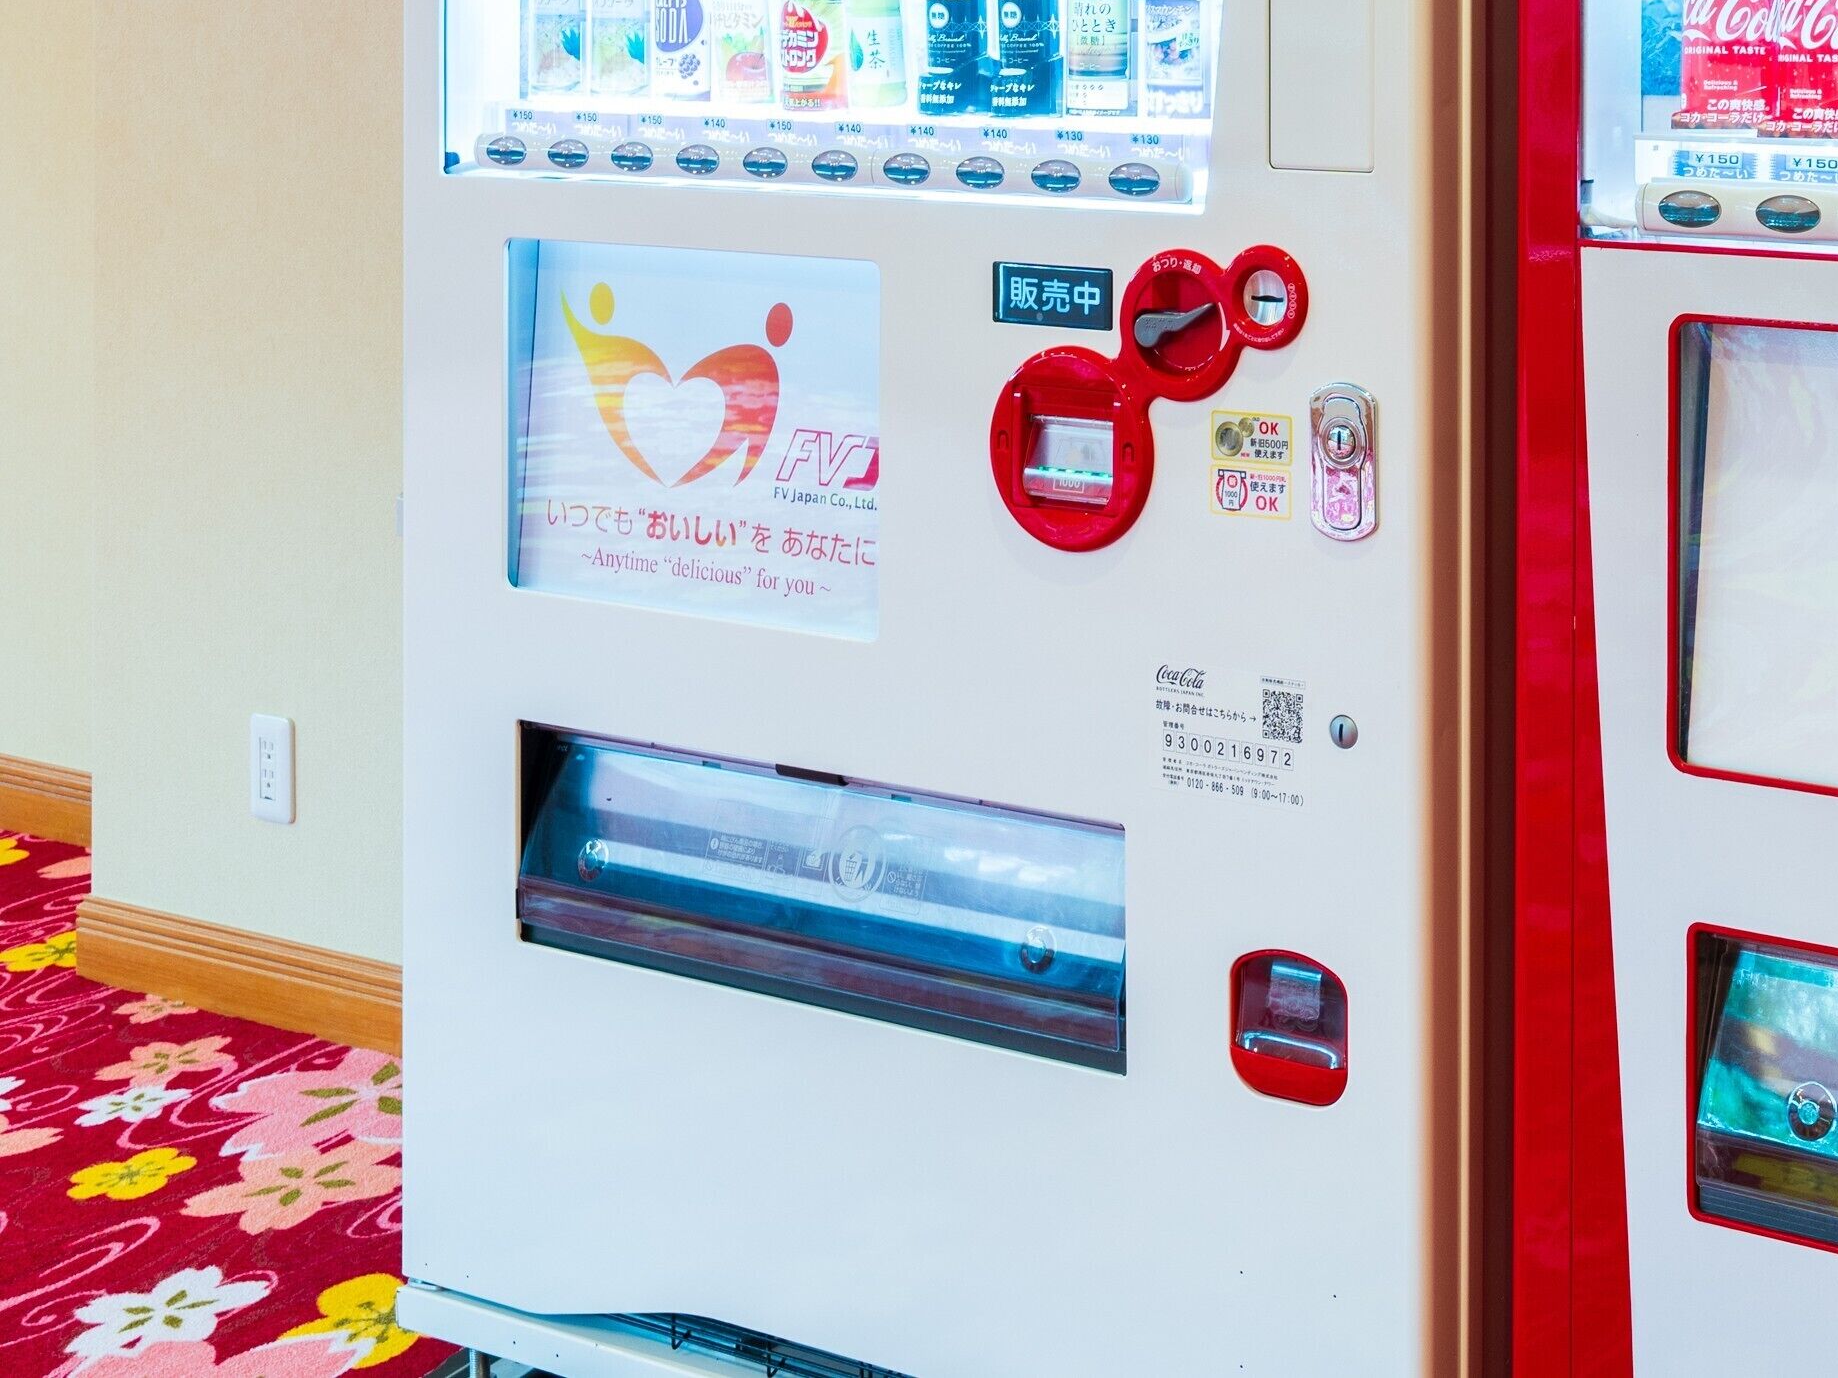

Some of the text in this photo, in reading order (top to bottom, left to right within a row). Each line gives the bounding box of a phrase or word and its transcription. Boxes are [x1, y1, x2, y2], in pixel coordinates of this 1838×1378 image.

[910, 126, 934, 136] ¥140
[1057, 131, 1083, 141] ¥130
[1010, 278, 1100, 315] 販売中
[1259, 422, 1278, 435] OK
[1255, 450, 1284, 459] 使えます
[774, 487, 878, 511] FV Japan Co., Ltd.
[781, 527, 875, 566] あなたに
[756, 568, 781, 590] for
[785, 575, 815, 597] you
[1156, 665, 1206, 689] Coca-Cola
